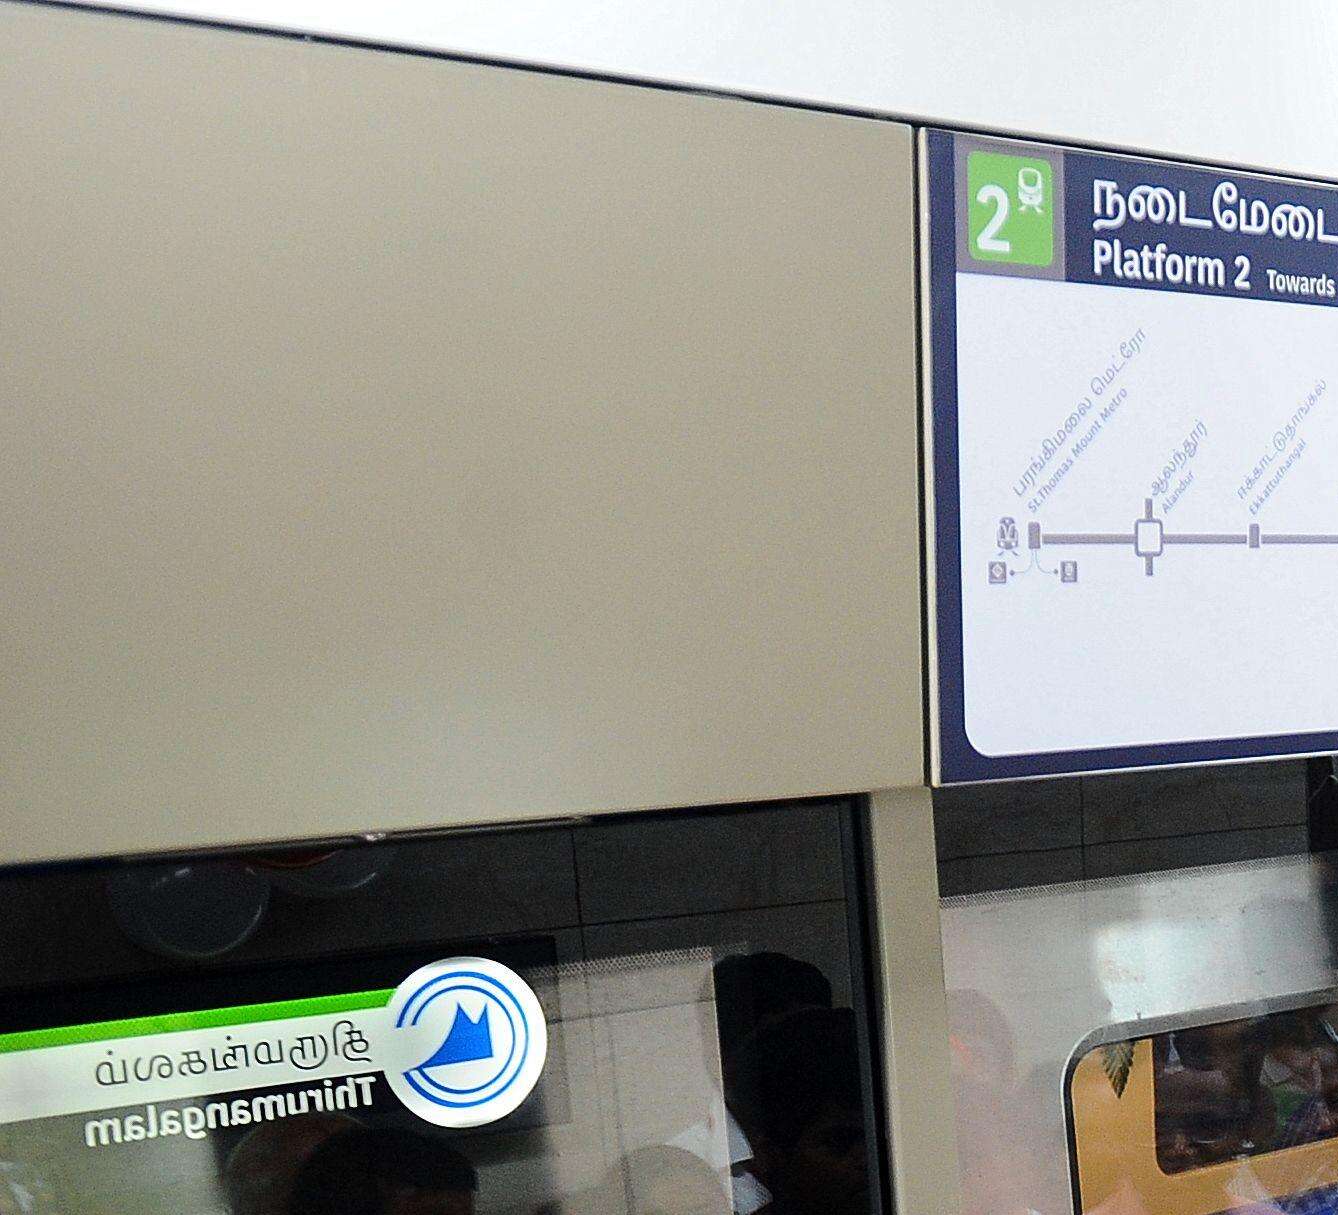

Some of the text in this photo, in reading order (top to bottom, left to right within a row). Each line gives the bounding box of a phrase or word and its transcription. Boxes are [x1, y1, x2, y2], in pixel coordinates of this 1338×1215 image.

[976, 184, 1010, 253] 2
[1093, 238, 1226, 289] Platform
[1234, 255, 1251, 290] 2
[1266, 268, 1336, 298] Towards
